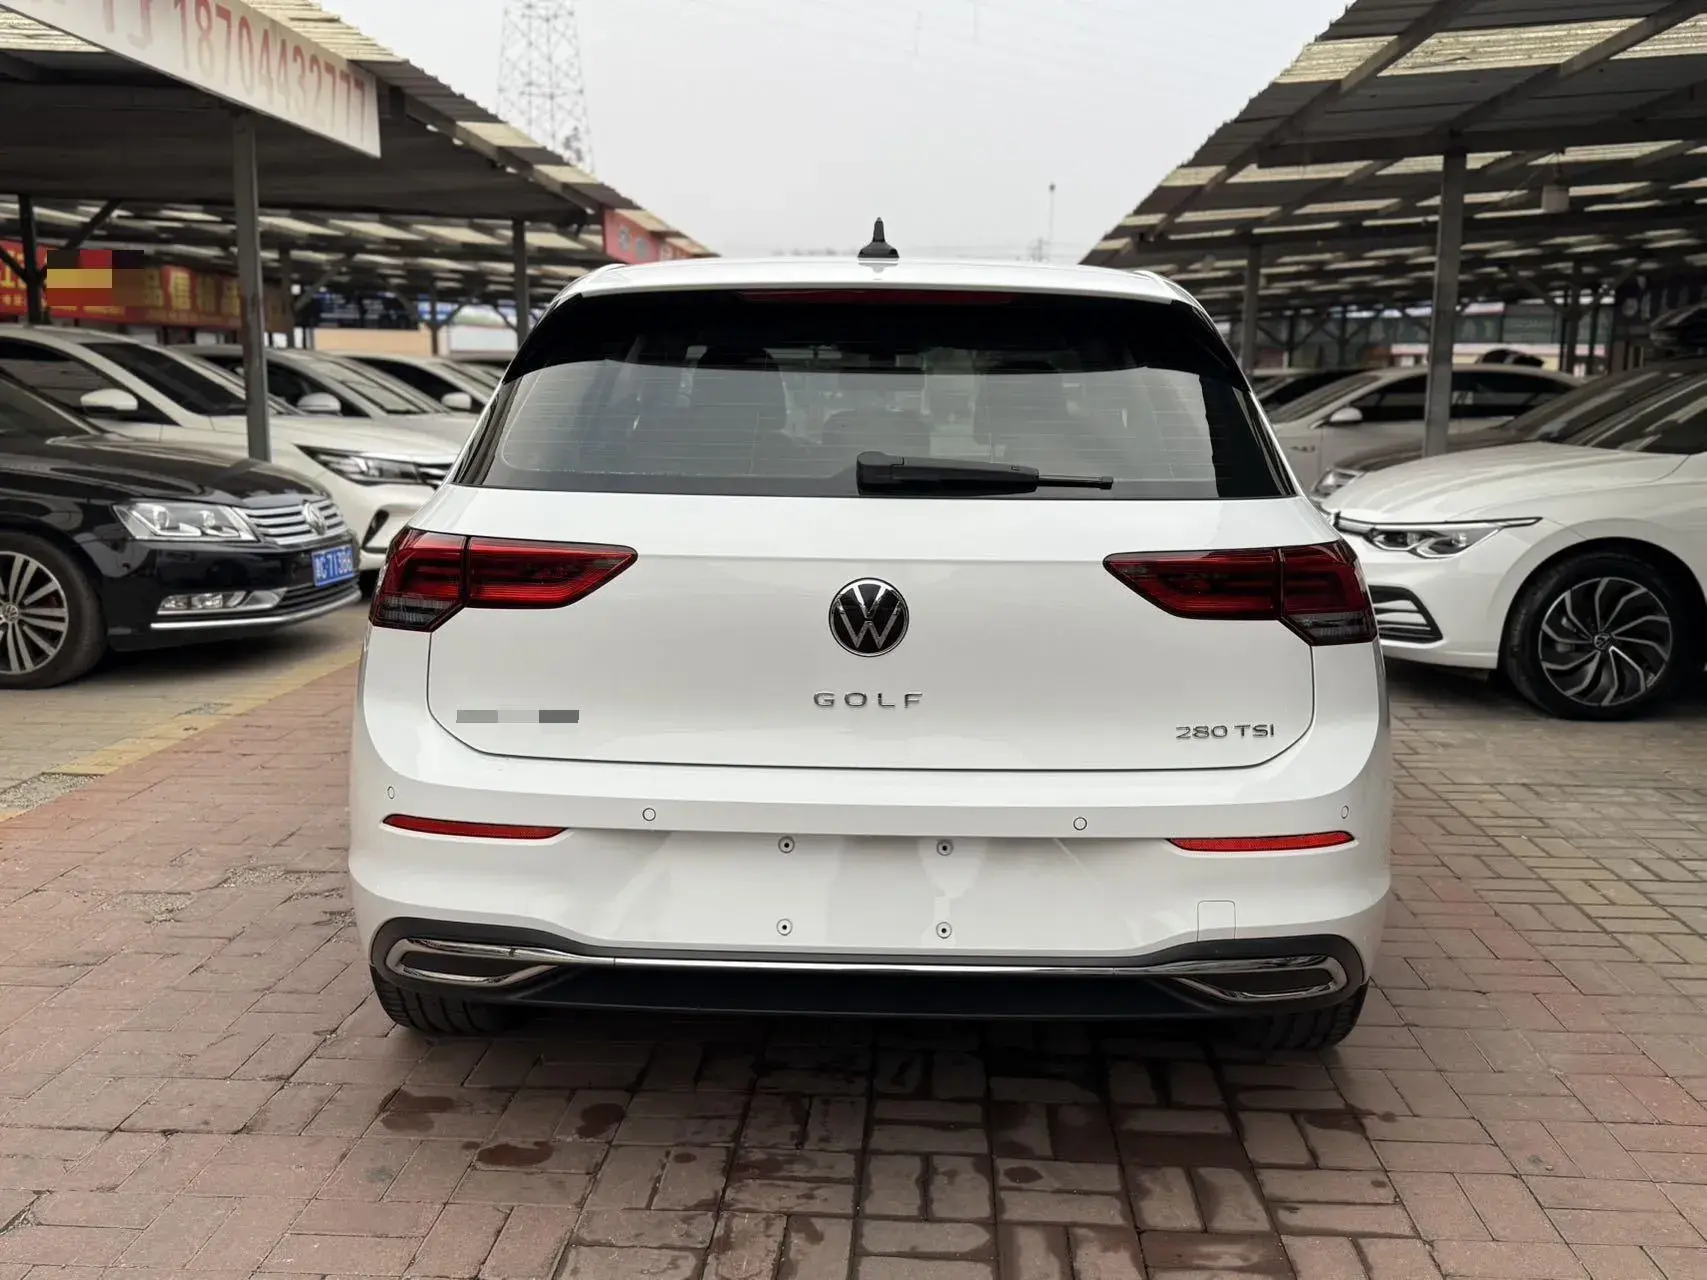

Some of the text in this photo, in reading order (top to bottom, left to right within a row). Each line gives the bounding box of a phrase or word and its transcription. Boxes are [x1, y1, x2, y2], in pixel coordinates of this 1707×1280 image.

[174, 0, 366, 144] 18704432777
[813, 691, 924, 709] GOLF
[1175, 723, 1275, 740] 280 TSI
